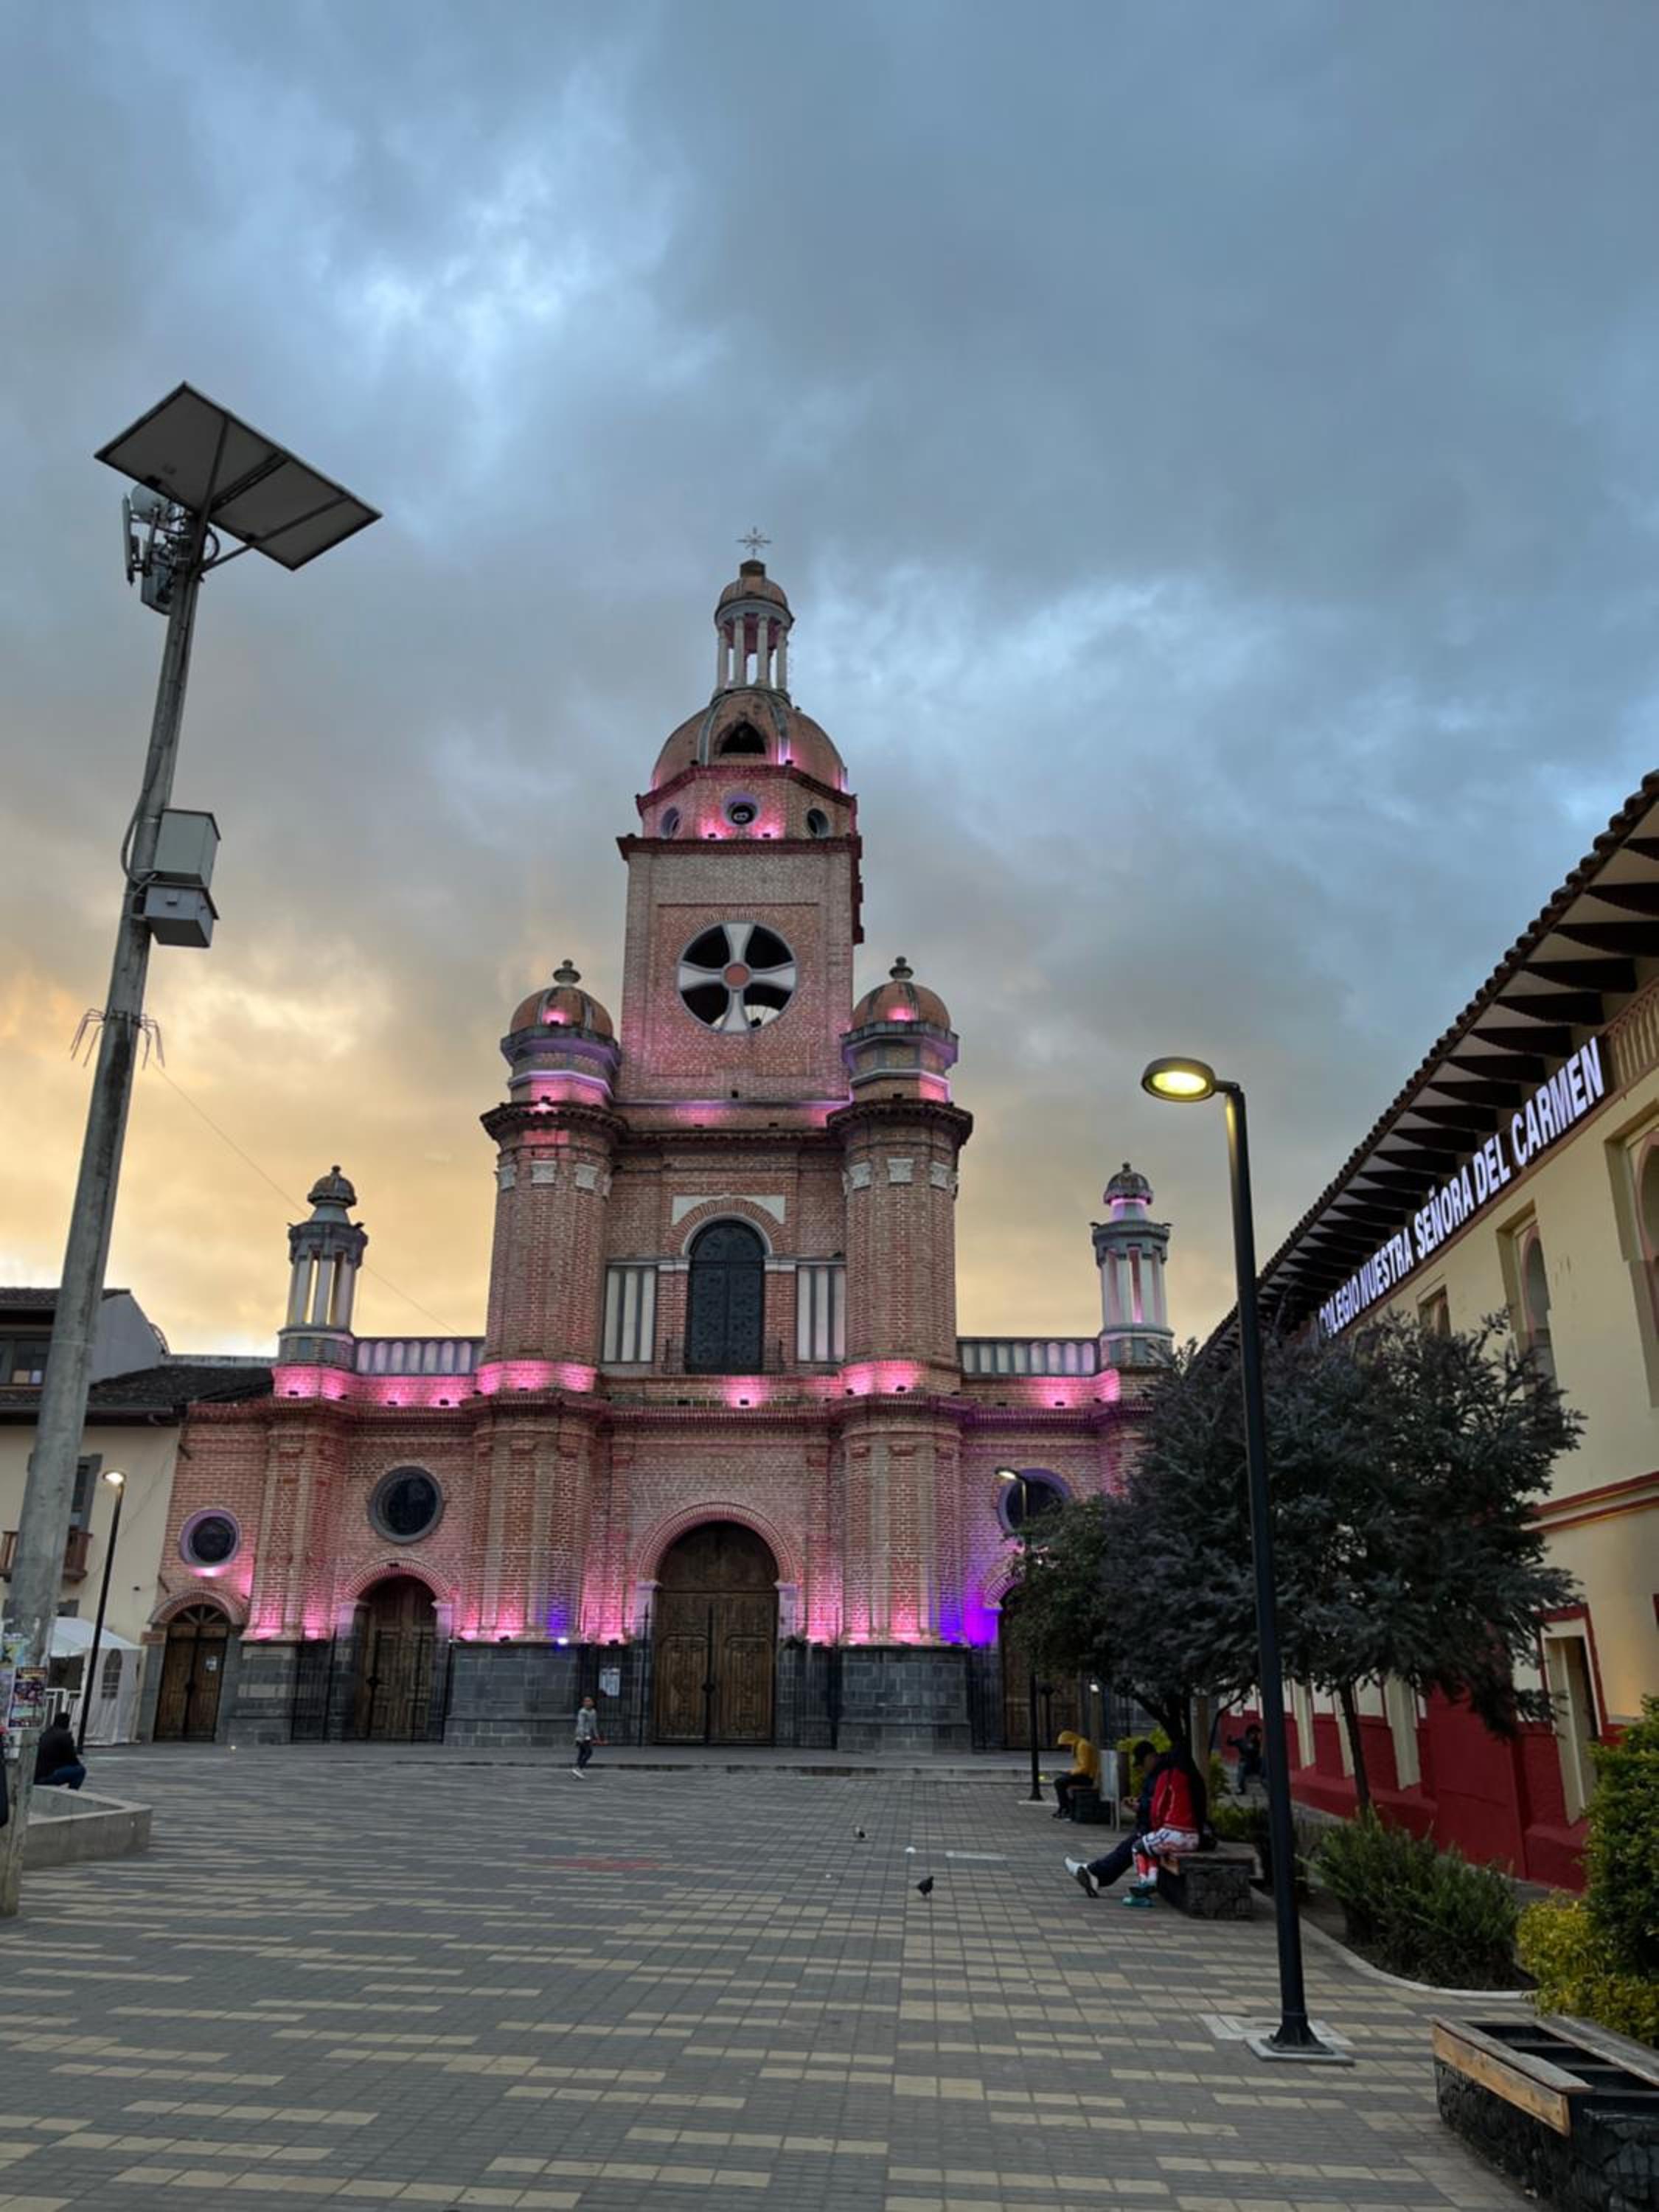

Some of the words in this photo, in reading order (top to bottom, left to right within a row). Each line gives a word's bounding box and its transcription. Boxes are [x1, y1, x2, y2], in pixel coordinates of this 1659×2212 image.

[1319, 1274, 1360, 1338] COLEGIO
[1360, 1227, 1414, 1310] NUESTRA
[1414, 1164, 1475, 1260] SEÑORA
[1472, 1133, 1512, 1205] DEL
[1511, 1036, 1605, 1167] CARMEN
